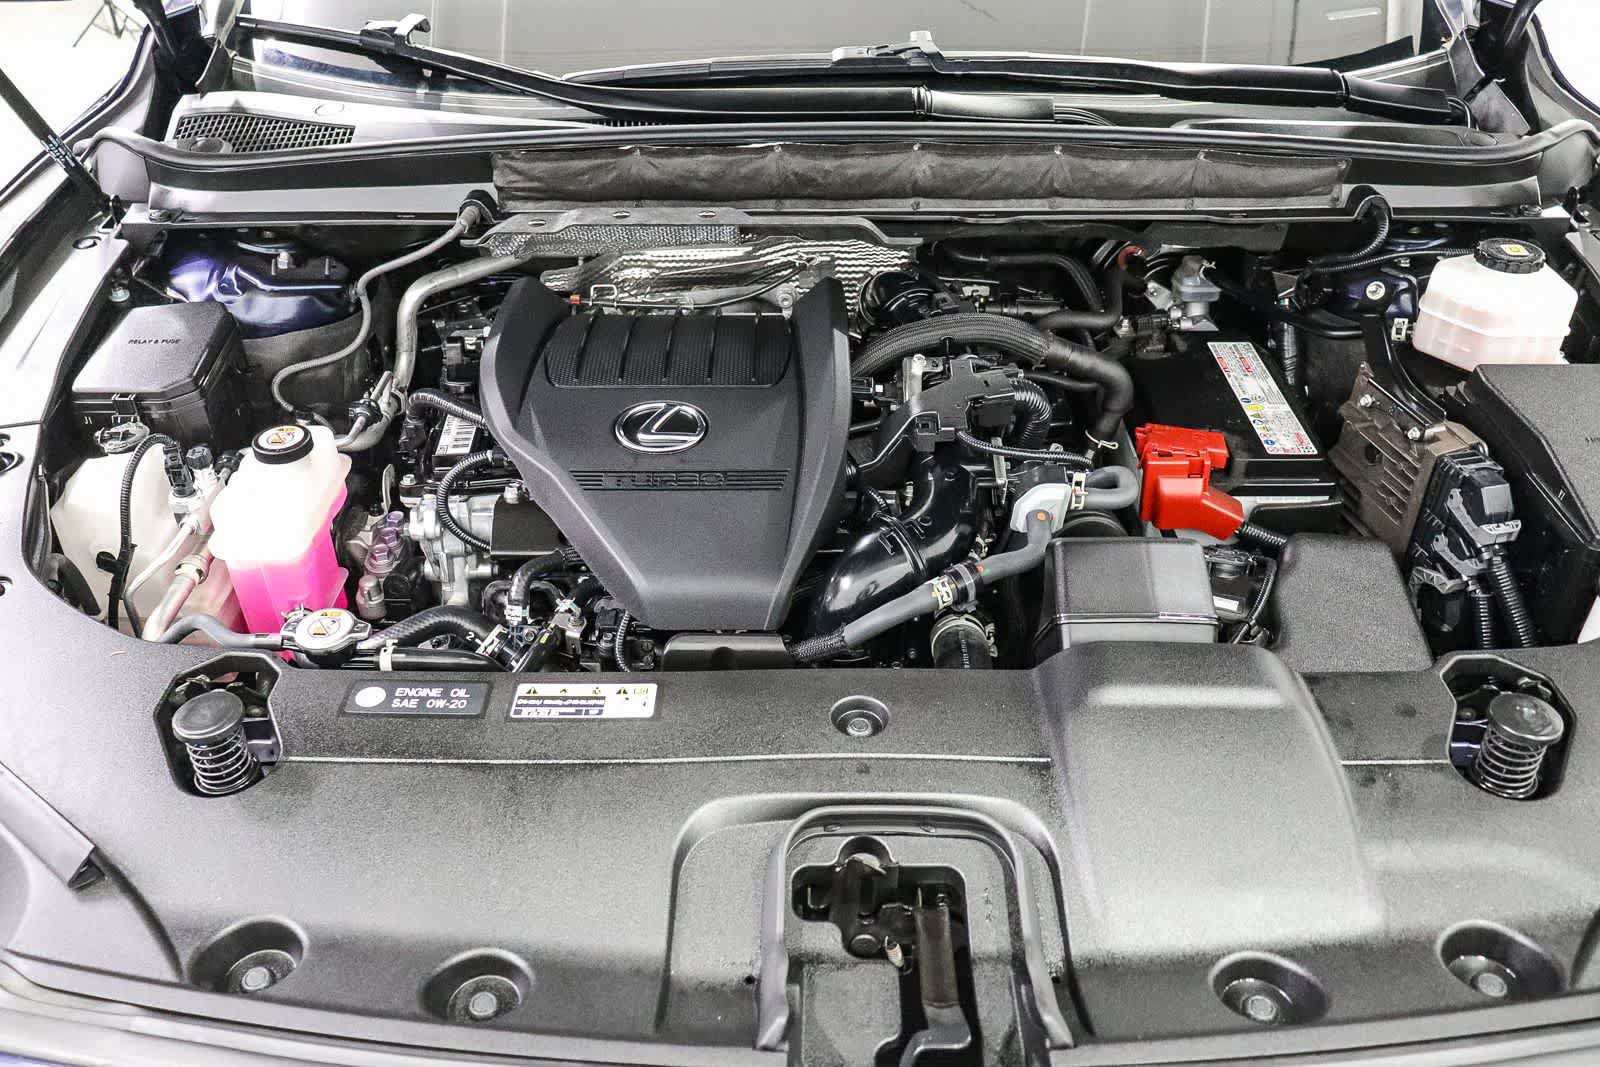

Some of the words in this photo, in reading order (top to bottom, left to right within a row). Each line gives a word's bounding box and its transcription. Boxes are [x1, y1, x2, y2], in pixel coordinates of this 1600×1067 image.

[394, 687, 443, 697] ENGINE
[450, 688, 471, 698] OIL
[391, 698, 420, 708] SAE
[426, 699, 468, 709] 0W-20
